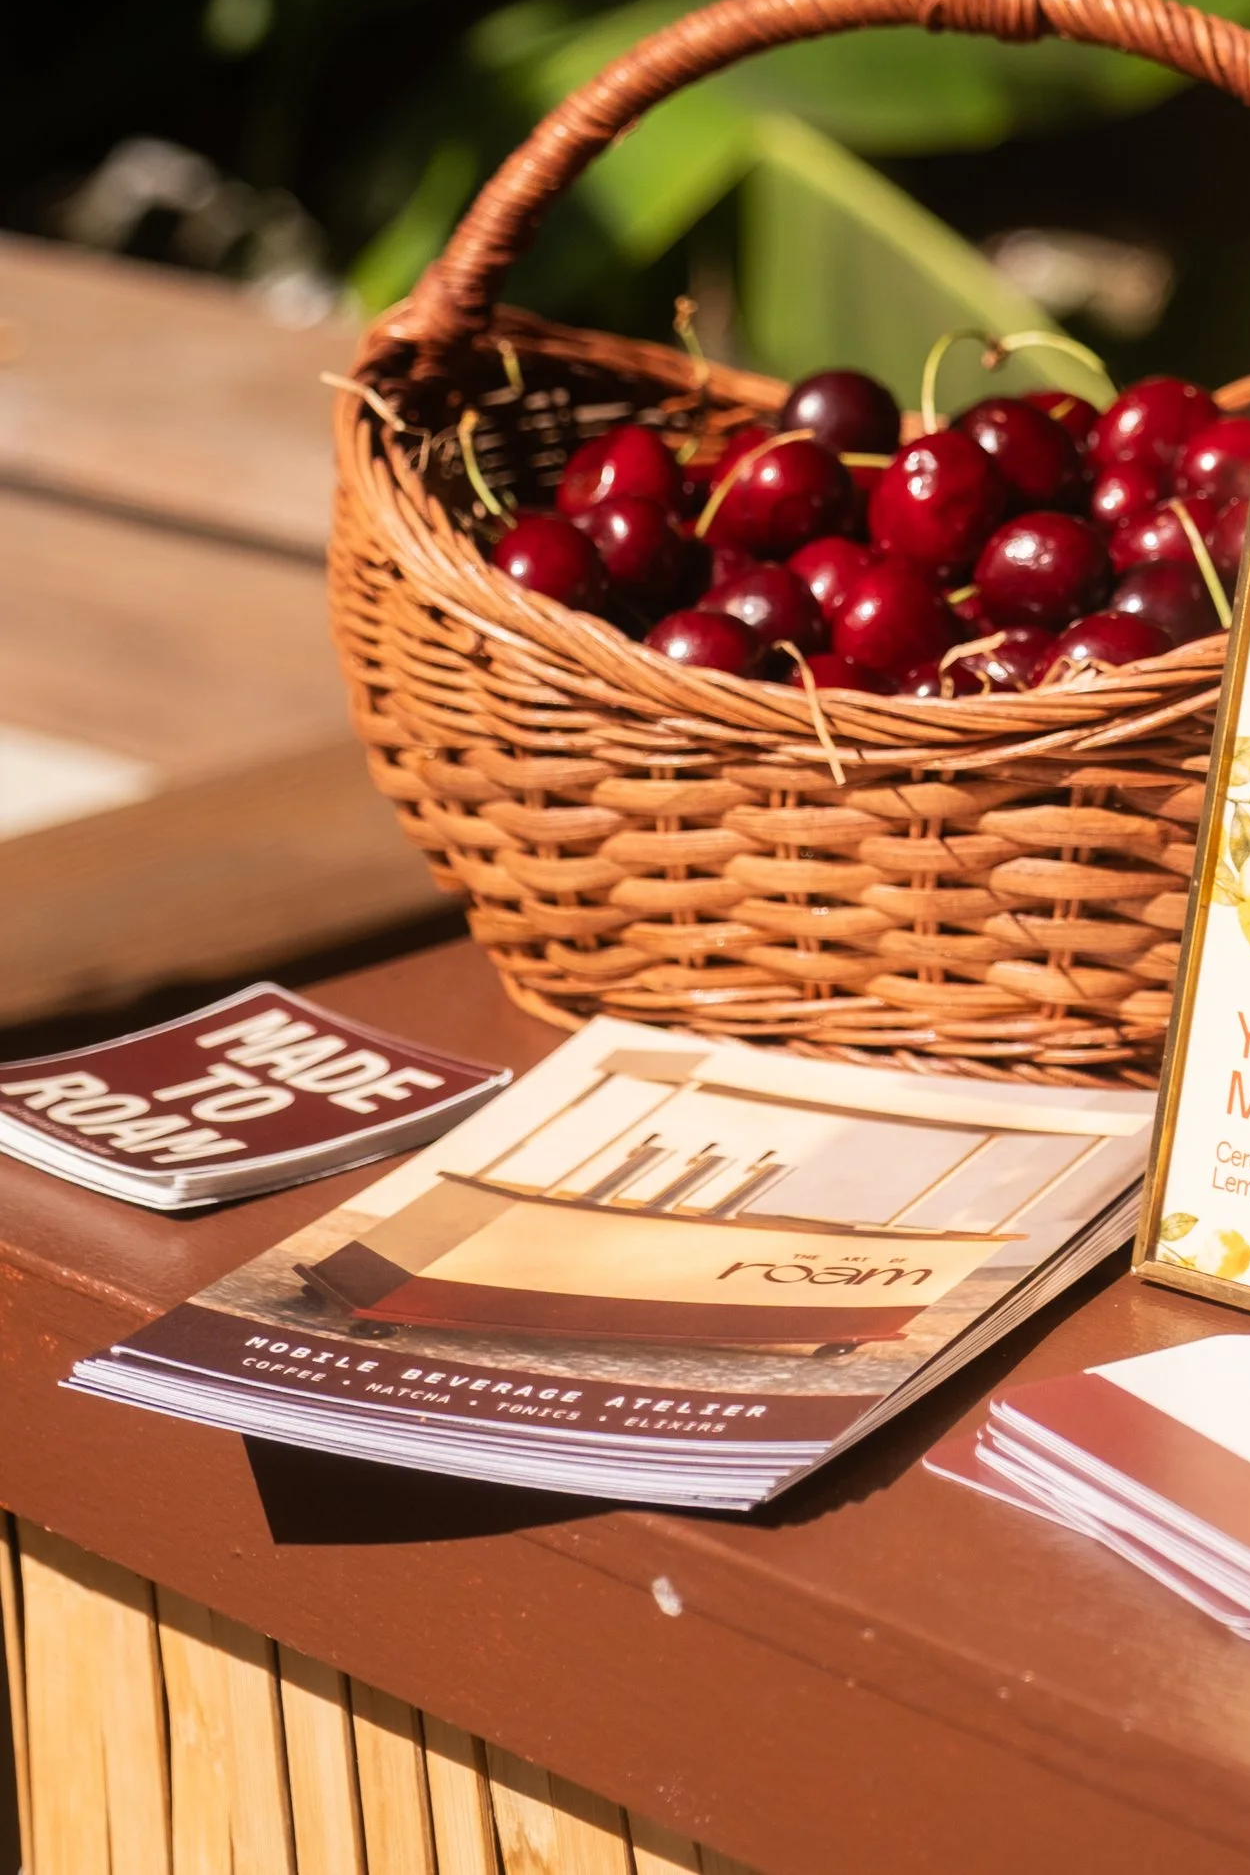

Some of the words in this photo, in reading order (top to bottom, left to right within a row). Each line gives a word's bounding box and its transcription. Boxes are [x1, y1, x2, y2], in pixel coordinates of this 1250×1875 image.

[153, 1062, 295, 1123] TO
[195, 1007, 444, 1114] MADE
[0, 1071, 247, 1164] ROAM
[716, 1262, 933, 1286] roam
[242, 1357, 325, 1382] COFFEE
[366, 1382, 451, 1403] MATCHA
[496, 1401, 581, 1421] TONICS
[624, 1416, 727, 1433] ELIXIRS
[246, 1336, 380, 1373] MOBILE
[402, 1367, 583, 1403] BEVERAGE
[606, 1395, 770, 1418] ATELIER
